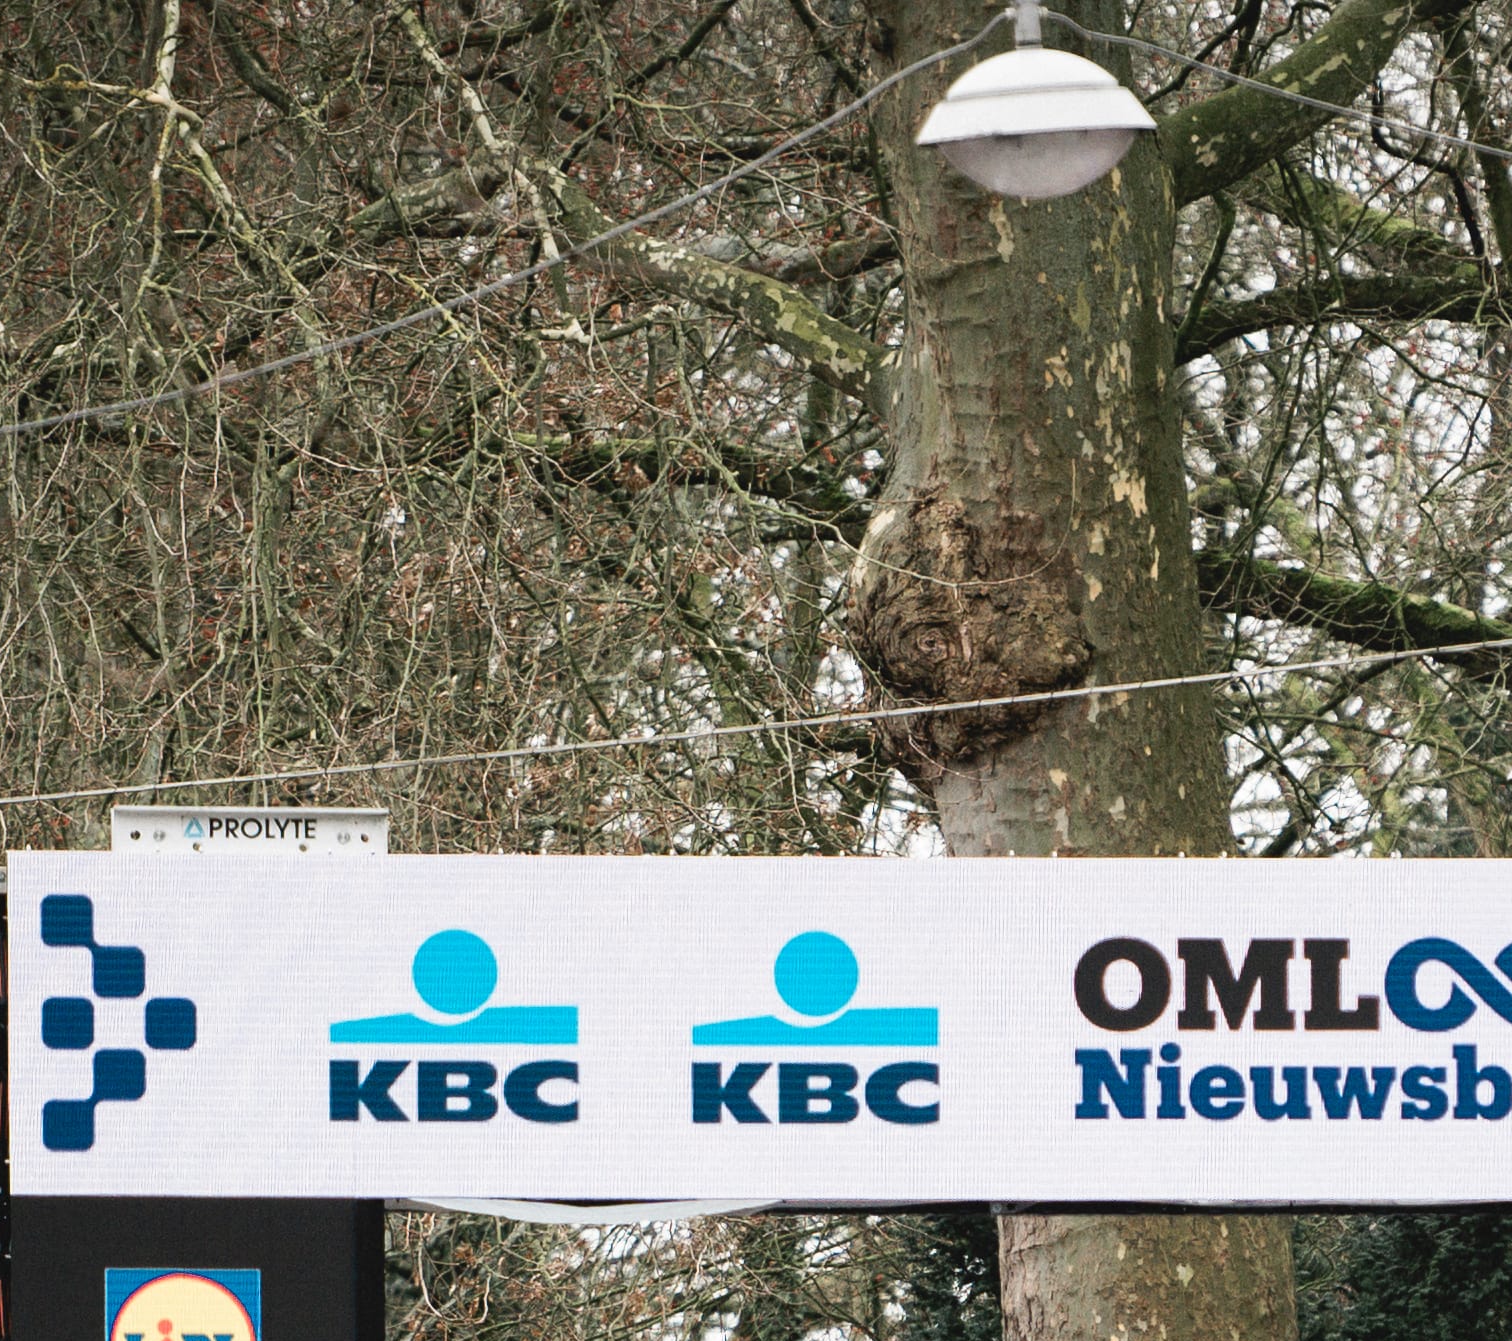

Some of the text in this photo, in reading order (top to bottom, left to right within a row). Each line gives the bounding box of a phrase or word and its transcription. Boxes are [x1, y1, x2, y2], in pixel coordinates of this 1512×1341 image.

[208, 817, 318, 839] PROLYTE
[329, 1060, 579, 1123] KBC
[691, 1061, 940, 1125] KBC
